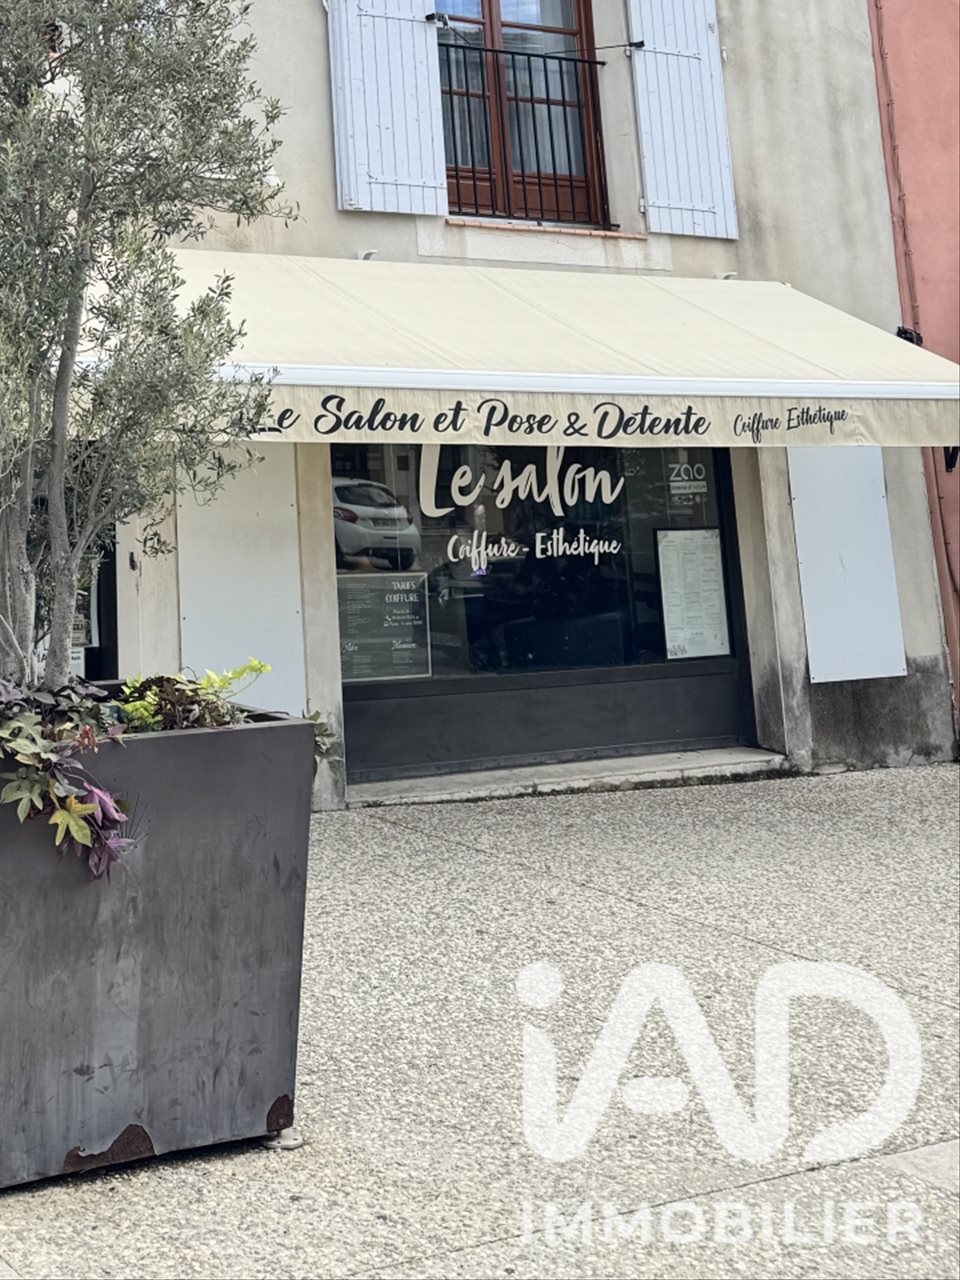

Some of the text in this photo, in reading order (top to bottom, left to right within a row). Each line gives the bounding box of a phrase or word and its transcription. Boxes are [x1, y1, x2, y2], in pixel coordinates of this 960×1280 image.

[314, 394, 426, 435] Salon
[434, 400, 468, 433] et
[477, 398, 558, 437] Pose
[563, 412, 589, 437] &
[733, 412, 782, 444] Coiffure
[419, 444, 625, 518] Le salon
[447, 529, 520, 571] Coiffure
[535, 527, 621, 565] Esthétique
[385, 593, 419, 604] COIFFURE
[392, 581, 417, 591] TARIFS
